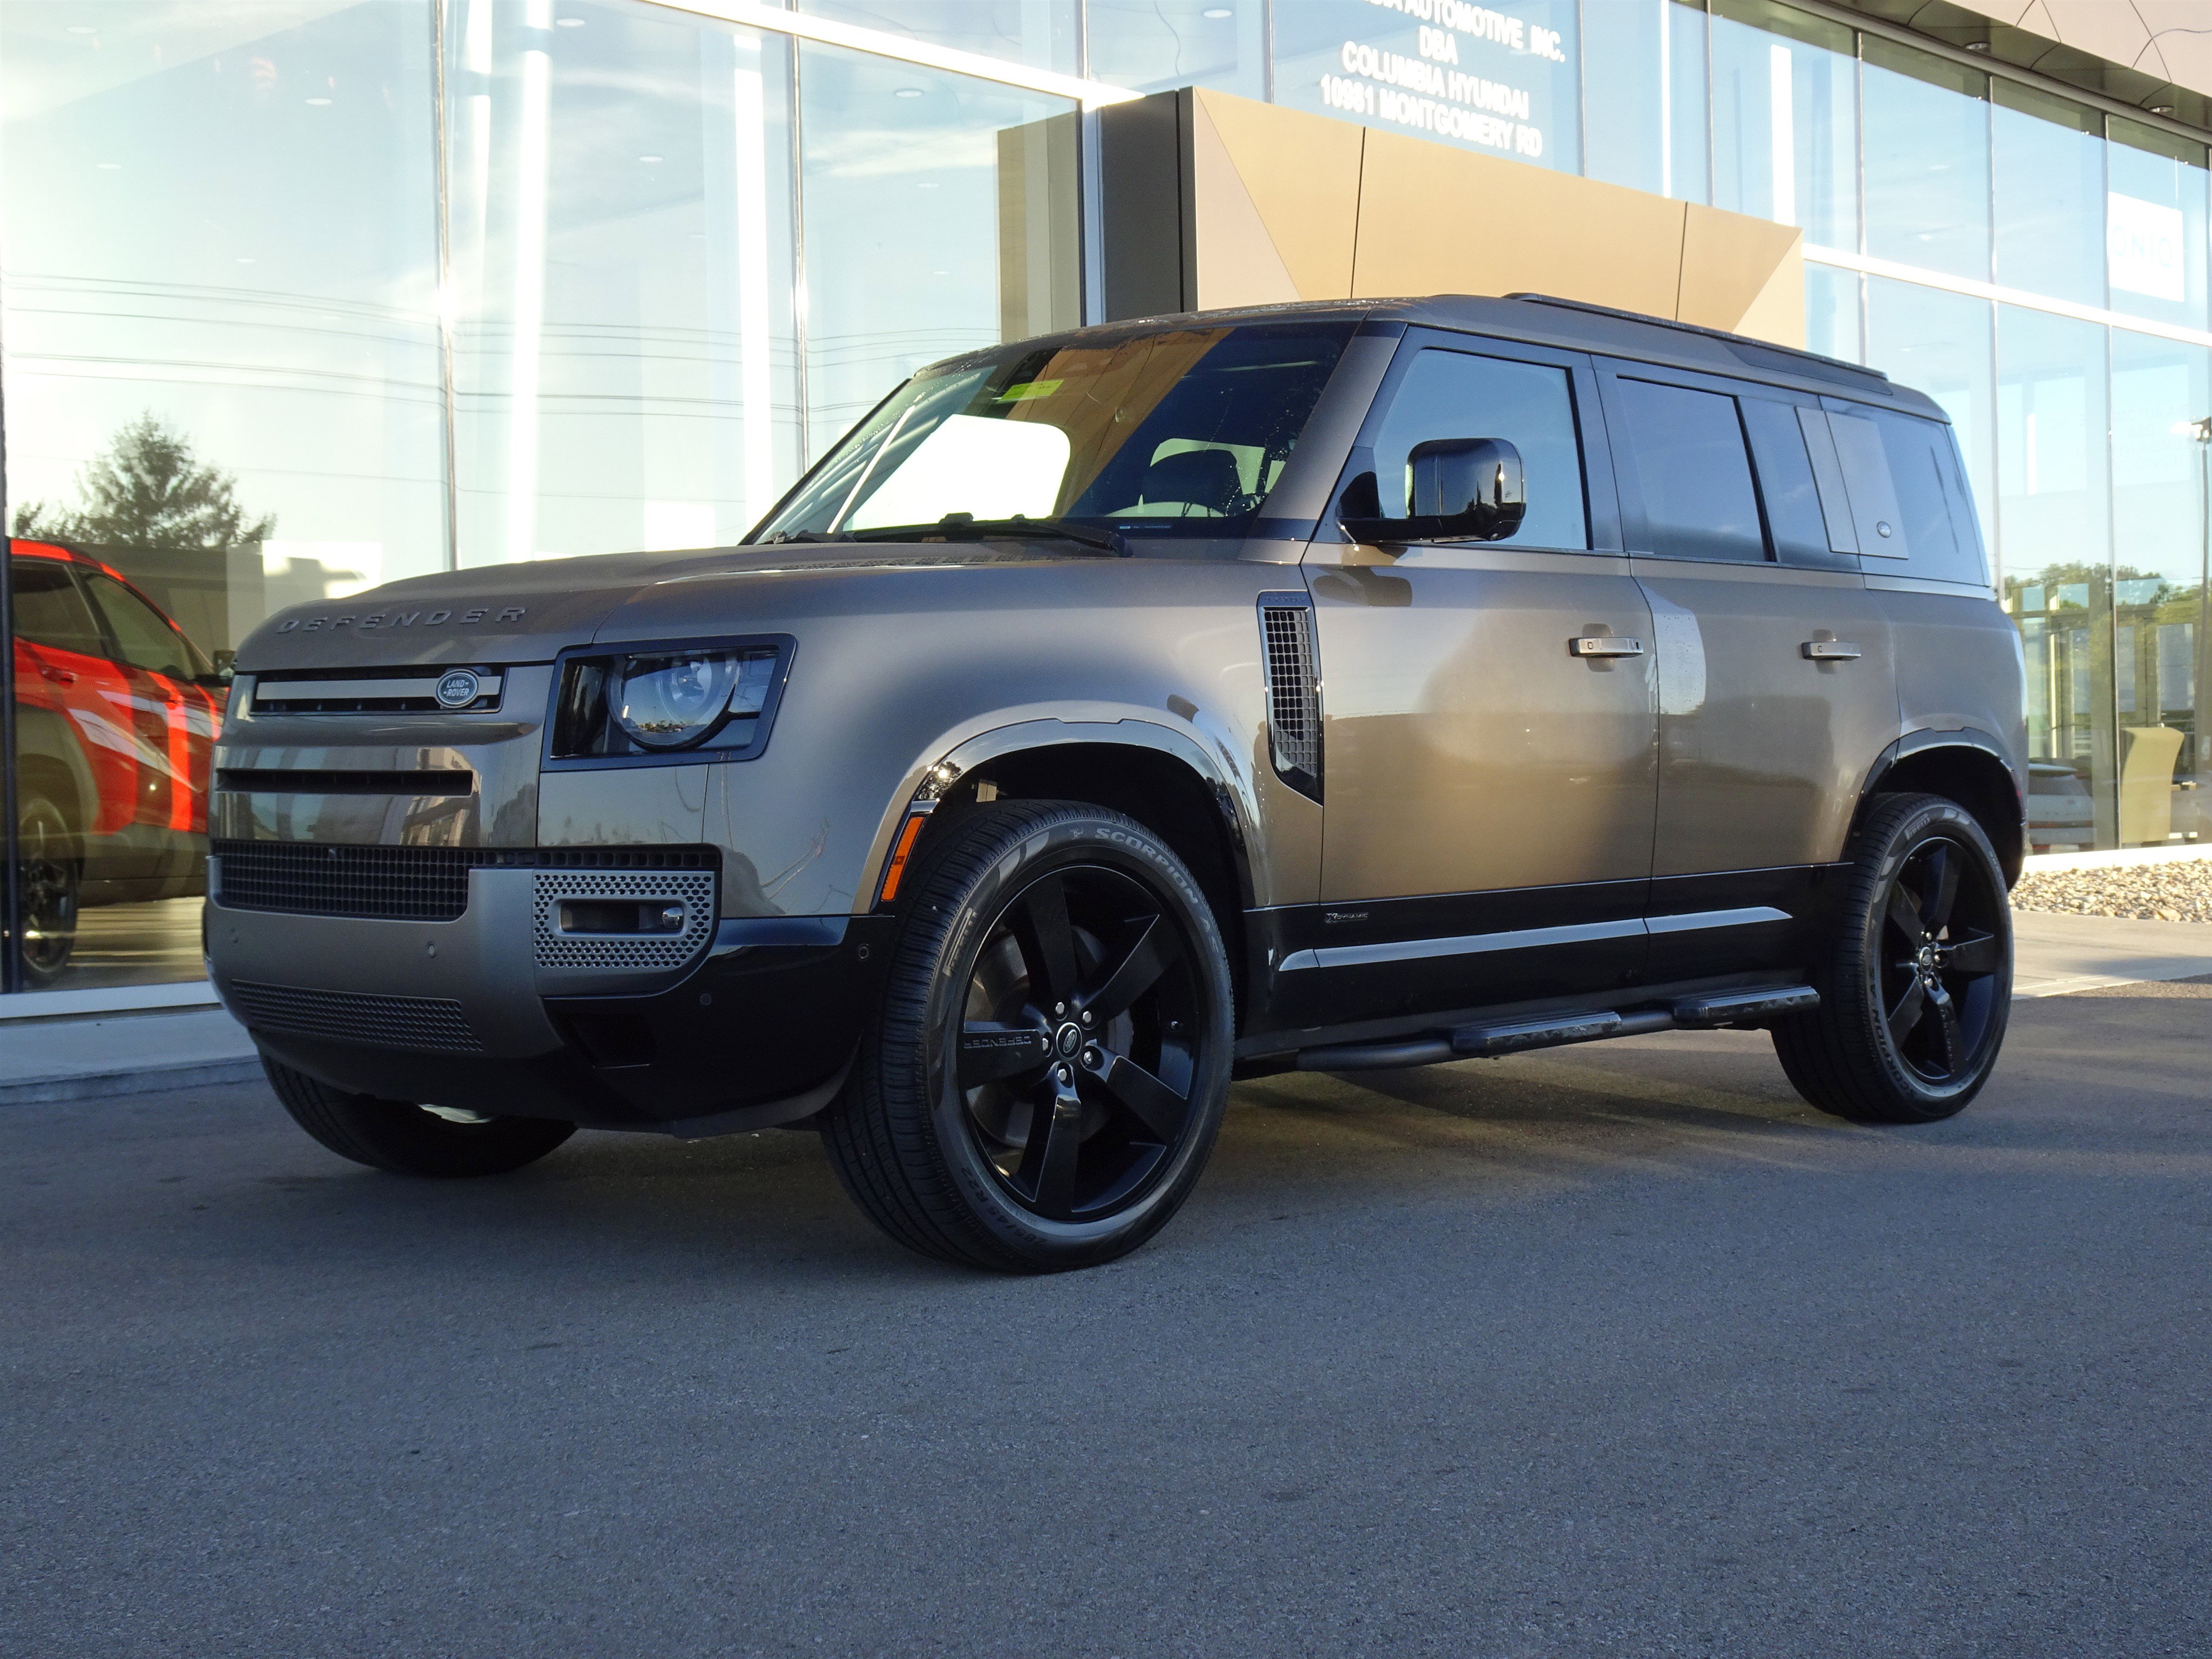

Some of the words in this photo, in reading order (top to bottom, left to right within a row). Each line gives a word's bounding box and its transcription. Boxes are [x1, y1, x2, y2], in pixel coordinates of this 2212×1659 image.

[1419, 25, 1458, 64] DBA
[1530, 25, 1565, 62] INC.
[1343, 41, 1446, 98] COLUMBIA
[1448, 70, 1529, 120] HYUNDAI
[1380, 89, 1514, 150] MONTGOMERY
[1516, 124, 1542, 157] RD
[276, 606, 527, 633] DEFENDER
[1094, 827, 1199, 905] SCORPION
